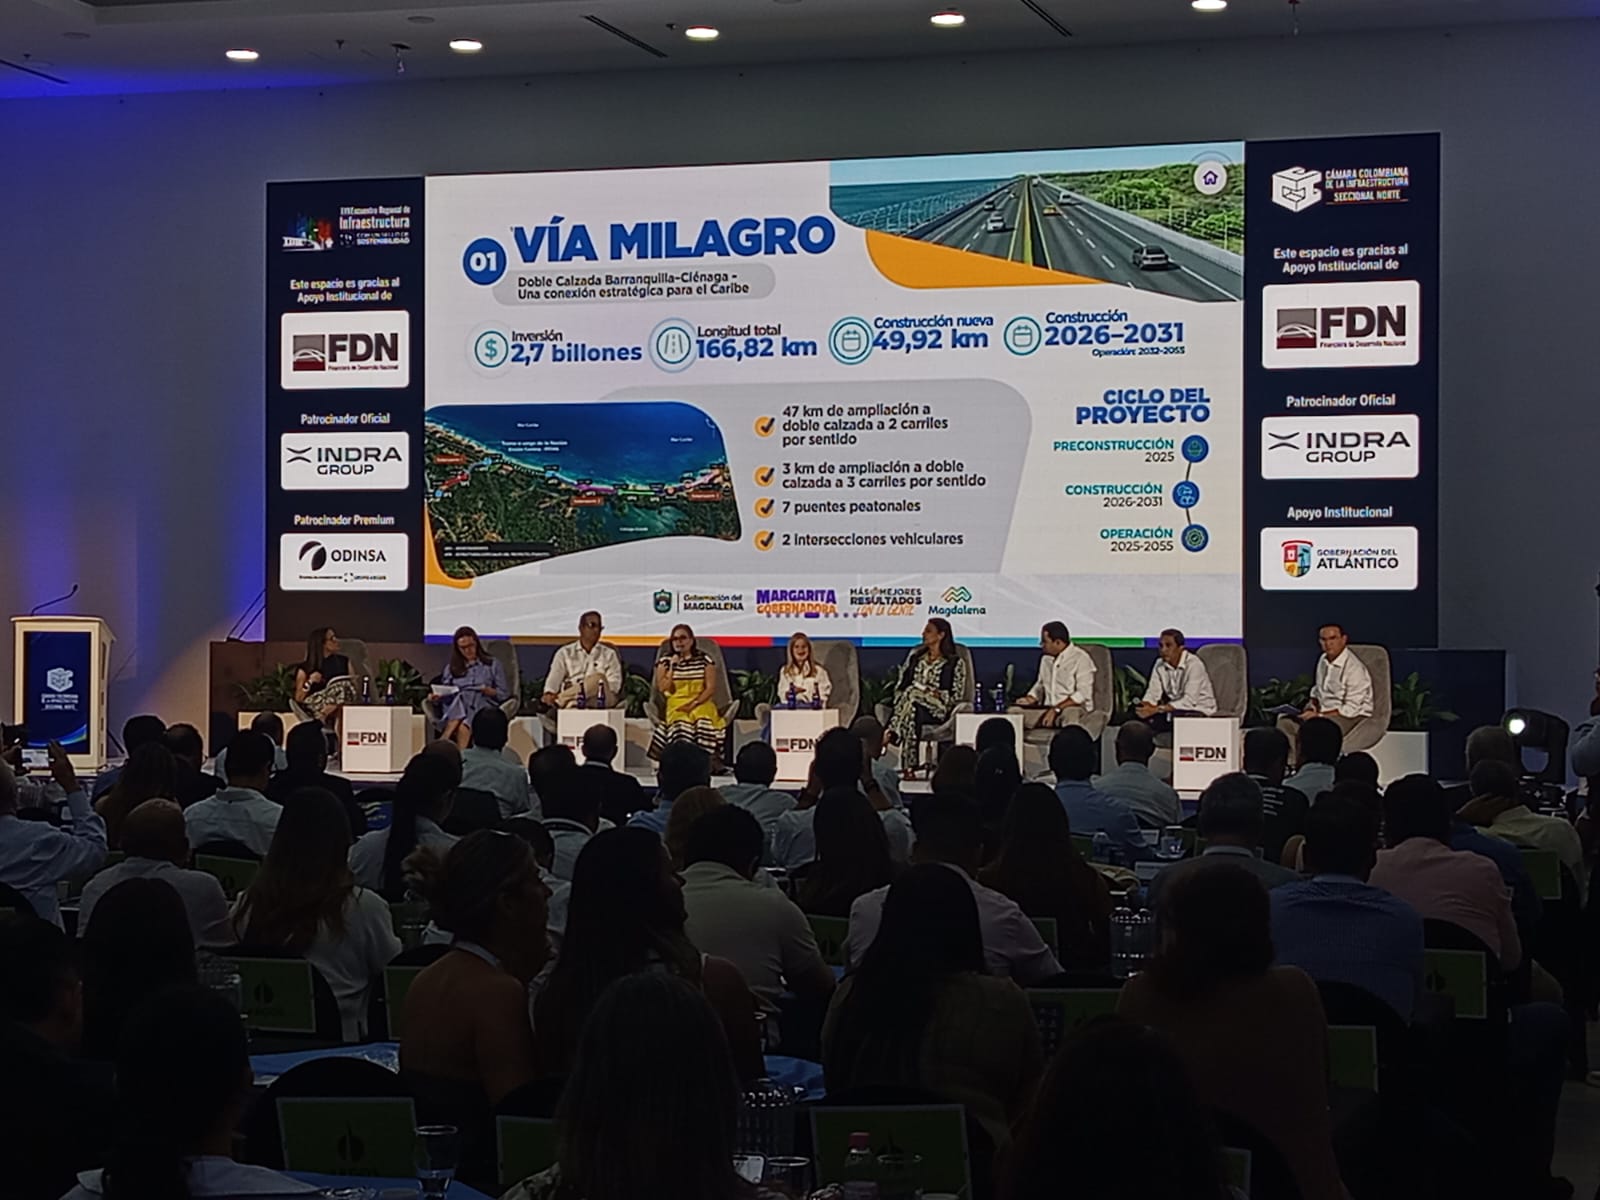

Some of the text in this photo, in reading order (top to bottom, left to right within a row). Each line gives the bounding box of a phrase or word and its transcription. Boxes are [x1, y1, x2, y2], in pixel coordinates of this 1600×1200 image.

[1325, 167, 1408, 179] CÁMARA COLOMBIANA
[1336, 180, 1344, 188] LA
[1346, 178, 1408, 188] INFRAESTRUCTURA
[340, 216, 410, 229] Infraestructura
[514, 215, 835, 263] VÍA MILAGRO
[1274, 243, 1408, 259] Este espacio es gracias al
[469, 251, 497, 271] 01
[1283, 259, 1399, 275] Apoyo Institucional de
[290, 277, 400, 290] Este espacio es gracias al
[518, 277, 553, 287] Doble
[556, 275, 602, 287] Calzada
[297, 291, 392, 304] Apoyo Institucional de
[518, 283, 749, 300] Una conexión estratégica para el Caribe
[874, 315, 993, 329] Construcción nueva
[1046, 310, 1128, 324] Construcción
[1320, 305, 1406, 339] FDN
[512, 330, 563, 342] Inversión
[698, 324, 781, 340] Longitud total
[328, 333, 398, 362] FDN
[872, 328, 988, 354] 49,92 km
[511, 343, 642, 366] 2,7 billones
[697, 338, 817, 361] 166,82 km
[1103, 388, 1210, 405] CICLO DEL
[1286, 394, 1396, 408] Patrocinador Oficial
[783, 403, 930, 418] 47 km de ampliación a
[1076, 405, 1210, 424] PROYECTO
[301, 413, 390, 425] Patrocinador Oficial
[783, 417, 948, 431] doble calzada a 2 carriles
[782, 433, 857, 448] por sentido
[1053, 438, 1174, 451] PRECONSTRUCCIÓN
[1306, 432, 1411, 448] INDRA
[317, 447, 402, 462] INDRA
[1145, 451, 1175, 462] 2025
[1306, 451, 1376, 463] GROUP
[317, 465, 374, 475] GROUP
[783, 460, 964, 476] 3 km de ampliación a doble
[783, 474, 986, 490] calzada a 3 carriles por sentido
[1065, 482, 1162, 495] CONSTRUCCIÓN
[783, 500, 921, 515] 7 puentes peatonales
[1103, 497, 1163, 507] 2026-2031
[1287, 506, 1393, 520] Apoyo Institucional
[294, 515, 395, 525] Patrocinador Premium
[782, 532, 963, 546] 2 intersecciones vehiculares
[1100, 526, 1173, 539] OPERACIÓN
[1111, 541, 1174, 552] 2025-2055
[1317, 548, 1379, 556] GOBERNACIÓN
[331, 550, 386, 562] ODINSA
[1316, 556, 1399, 569] ATLÁNTICO
[733, 593, 743, 601] del
[756, 590, 837, 604] MARGARITA
[879, 588, 922, 596] MEJORES
[683, 602, 744, 611] MAGDALENA
[850, 596, 922, 605] RESULTADOS
[757, 603, 836, 614] GOBERNADORA
[928, 605, 986, 617] Magdalena
[360, 732, 387, 743] FDN
[1195, 746, 1226, 759] FDN
